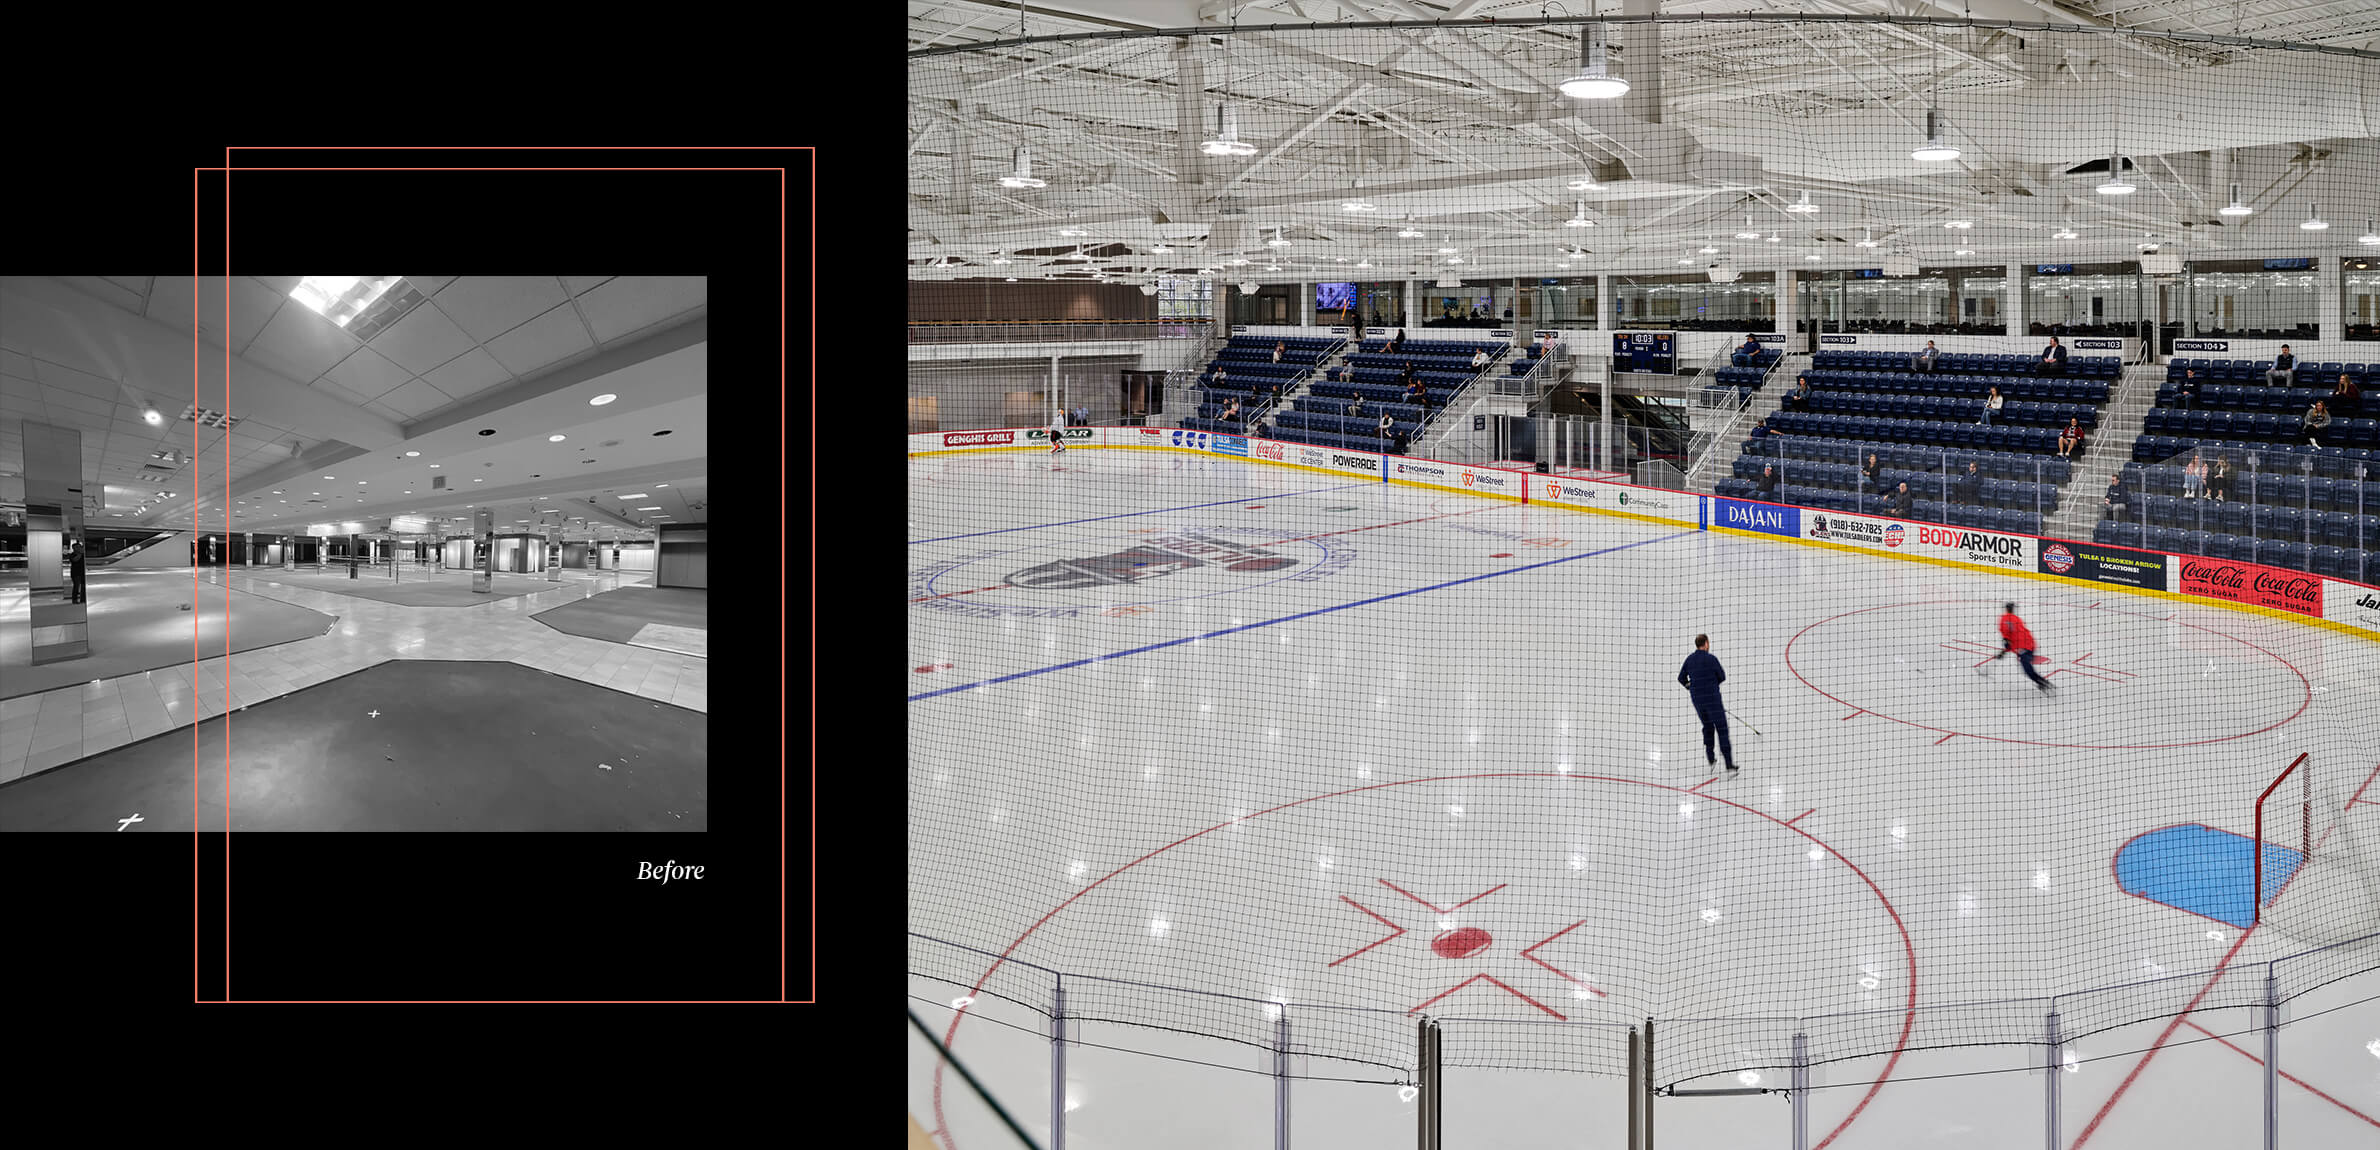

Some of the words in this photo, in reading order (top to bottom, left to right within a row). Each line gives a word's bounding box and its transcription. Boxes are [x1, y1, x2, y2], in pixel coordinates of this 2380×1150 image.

[1622, 341, 1627, 350] 8
[1662, 342, 1667, 351] 0
[2107, 341, 2121, 349] 103
[2203, 342, 2218, 350] 104
[947, 433, 985, 444] GENGHIS
[986, 431, 1012, 443] GRILL
[1332, 454, 1377, 471] POWERADE
[1405, 464, 1445, 476] THOMPSON
[1475, 474, 1505, 487] WeStreet
[1562, 485, 1596, 499] WeStreet
[1728, 504, 1784, 529] DASANI
[1919, 526, 2023, 557] BODYARMOR
[1968, 551, 1997, 563] Sports
[1999, 556, 2023, 567] Drink
[2045, 554, 2072, 563] GENESIS
[2079, 553, 2100, 561] TULSA
[2106, 557, 2134, 566] BROKEN
[2135, 560, 2162, 569] ARROW
[2188, 586, 2209, 594] ZERO
[2212, 589, 2238, 599] SUGAR
[2261, 597, 2282, 607] ZERO
[2285, 602, 2312, 613] SUGAR
